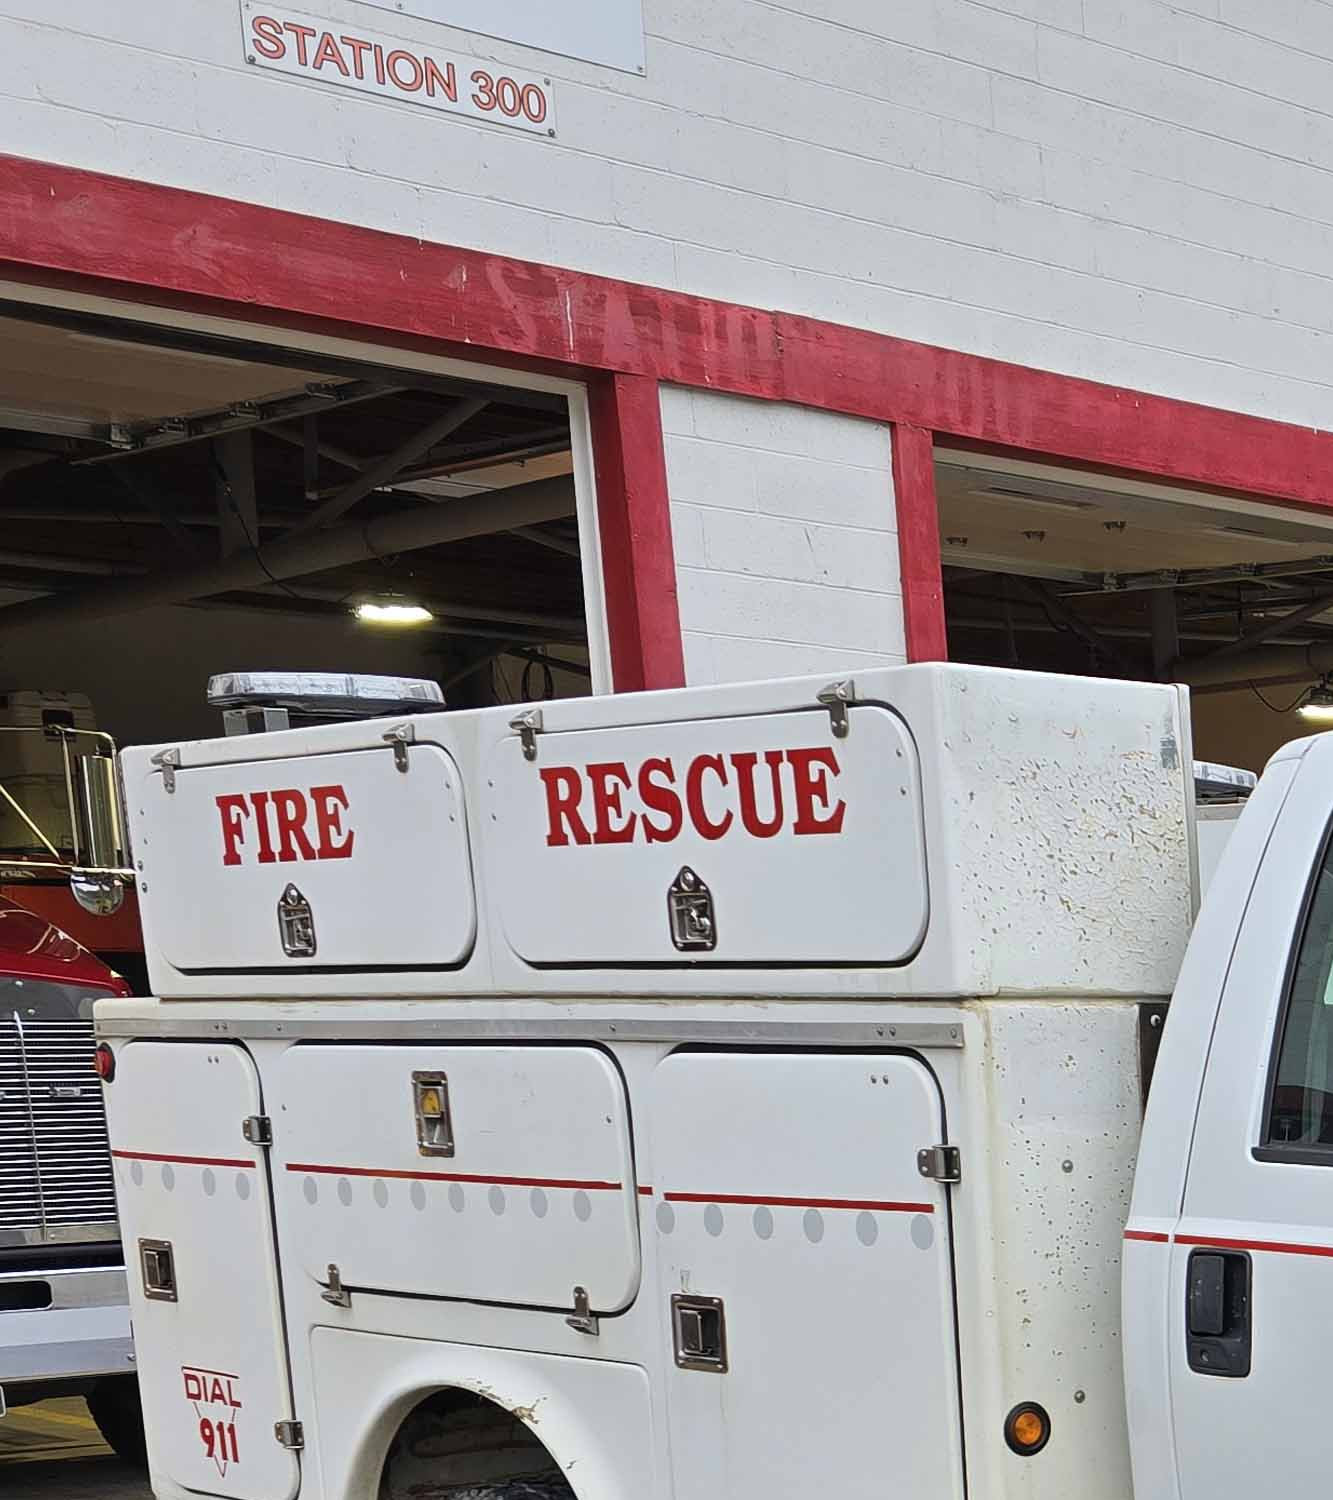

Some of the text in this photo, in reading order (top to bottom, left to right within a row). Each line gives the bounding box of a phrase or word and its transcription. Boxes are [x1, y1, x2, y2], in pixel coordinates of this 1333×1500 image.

[252, 15, 548, 124] STATION 300
[215, 785, 356, 867] FIRE
[539, 746, 847, 848] RESCUE
[184, 1373, 242, 1409] DIAL
[200, 1416, 241, 1464] 911
